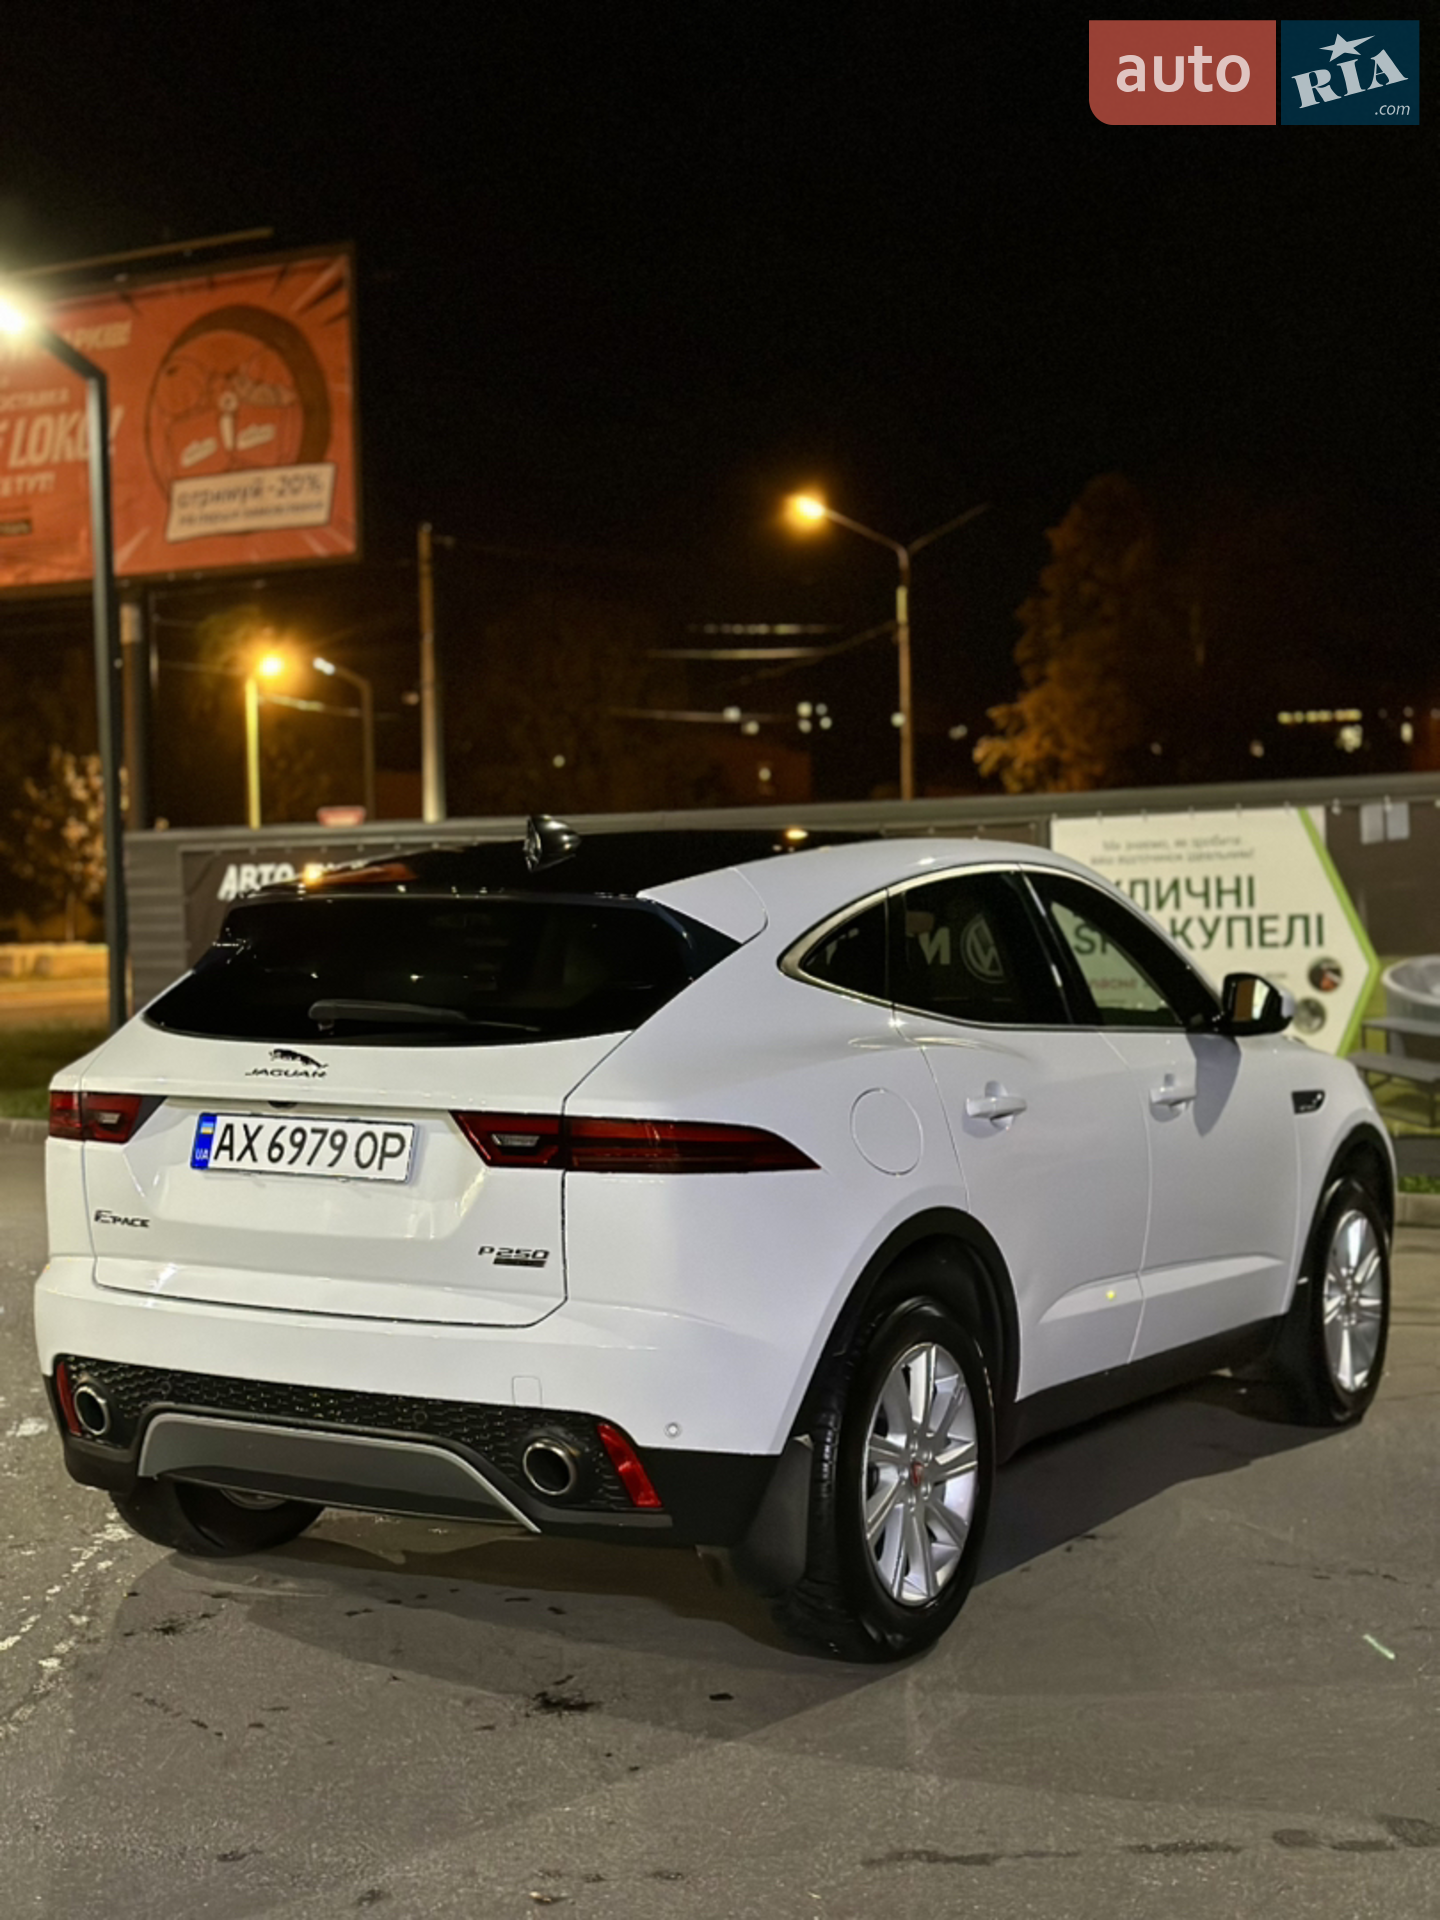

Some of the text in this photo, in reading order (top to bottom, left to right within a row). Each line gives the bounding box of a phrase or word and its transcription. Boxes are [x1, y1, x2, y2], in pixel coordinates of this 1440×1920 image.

[1115, 875, 1255, 911] ЛИЧНІ
[1170, 912, 1325, 951] КУПЕЛІ
[213, 1122, 406, 1171] AX 6979 OP
